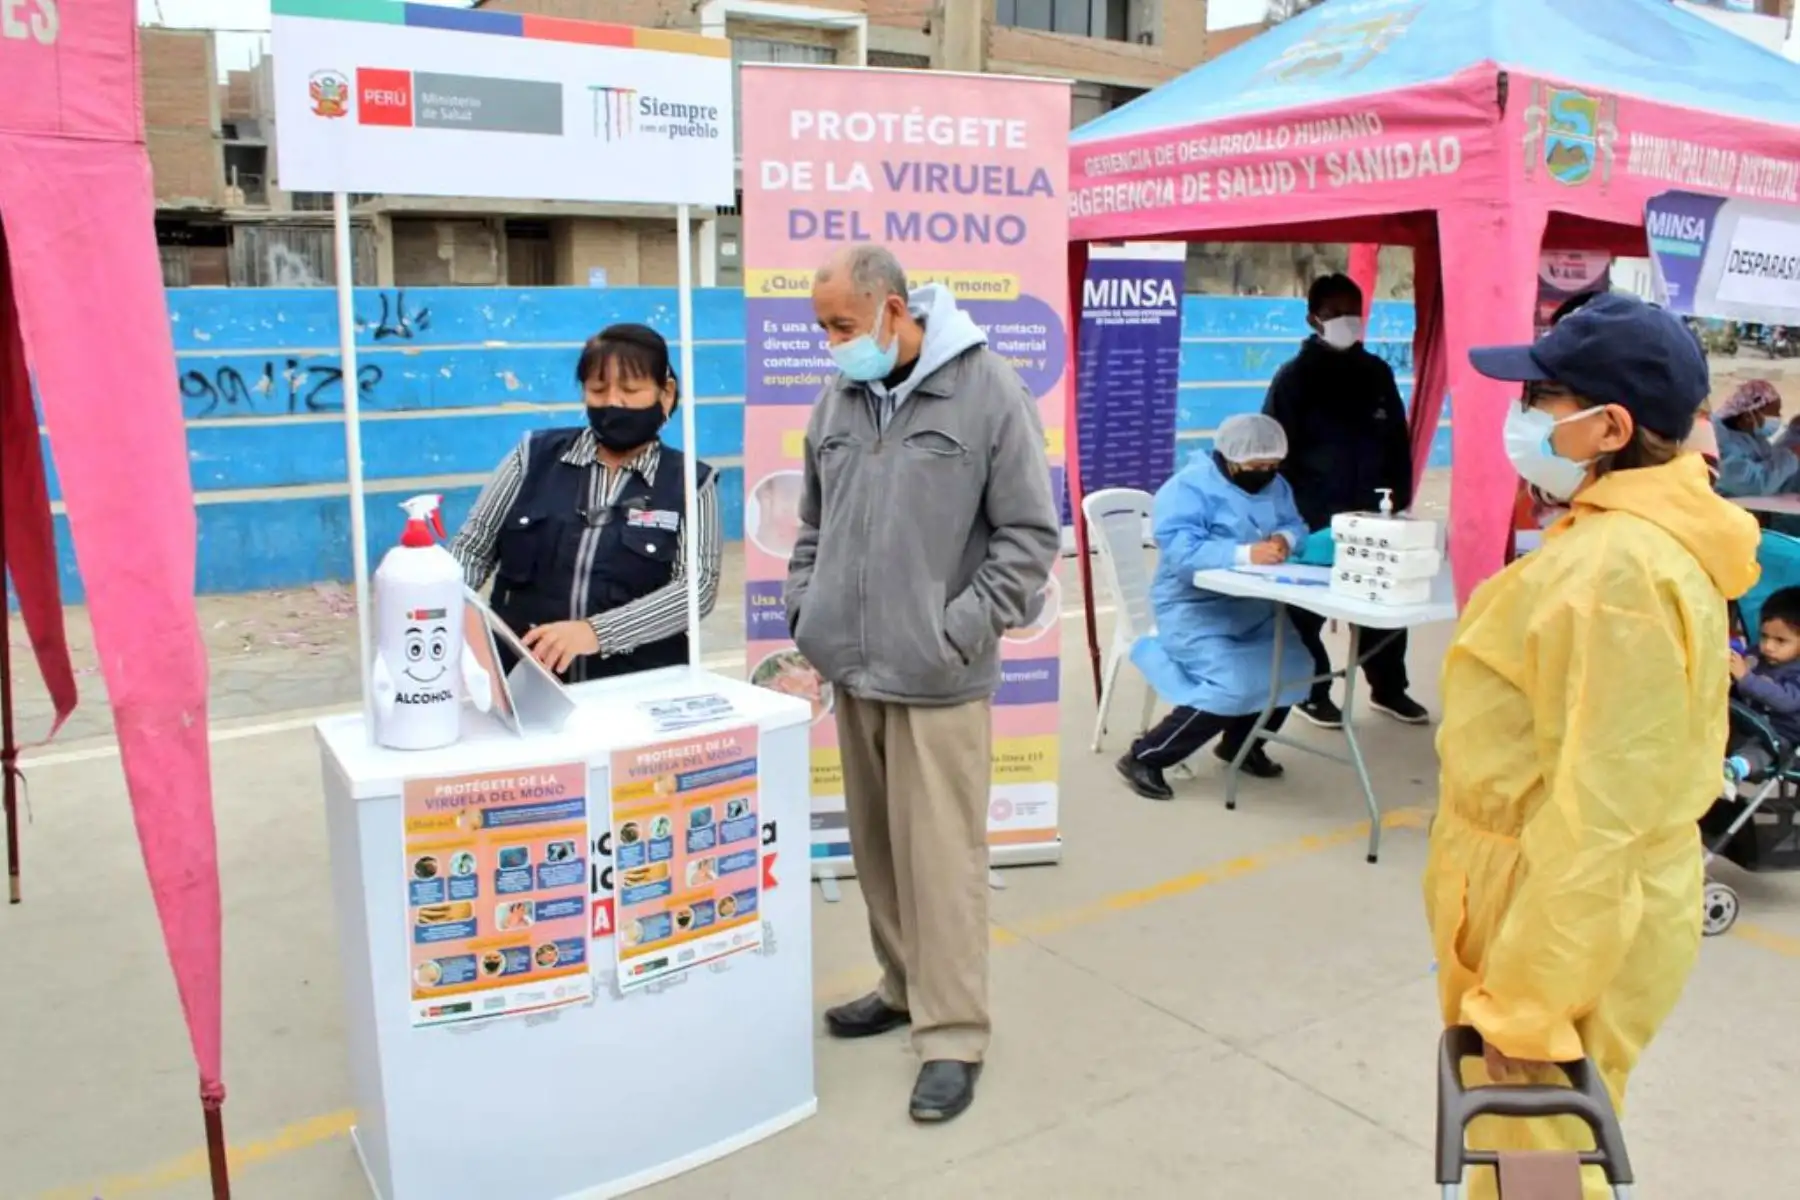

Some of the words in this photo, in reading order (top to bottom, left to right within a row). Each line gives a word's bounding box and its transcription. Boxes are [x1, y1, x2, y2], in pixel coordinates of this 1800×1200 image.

[364, 87, 407, 107] PERÚ
[639, 95, 718, 123] Siempre
[668, 122, 719, 140] pueblo
[790, 106, 1027, 149] PROTÉGETE
[1085, 148, 1151, 177] GERENCIA
[1155, 143, 1175, 166] DE
[1179, 129, 1290, 161] DESARROLLO
[1294, 112, 1383, 147] HUMANO
[760, 160, 813, 191] DE
[825, 160, 873, 192] LA
[882, 161, 1055, 198] VIRUELA
[1182, 171, 1212, 204] DE
[1217, 160, 1296, 200] SALUD
[1299, 155, 1317, 189] Y
[1325, 136, 1461, 187] SANIDAD
[1628, 131, 1736, 191] MUNICIPALIDAD
[1736, 155, 1798, 202] DISTRITAL
[788, 209, 870, 241] DEL
[885, 211, 1027, 246] MONO
[1649, 211, 1706, 241] MINSA
[760, 277, 809, 294] ¿Qué
[954, 279, 1011, 293] mono?
[1083, 279, 1177, 307] MINSA
[763, 320, 778, 333] Es
[782, 322, 807, 333] una
[995, 323, 1047, 334] contacto
[763, 337, 811, 350] directo
[997, 340, 1046, 352] material
[763, 373, 821, 388] erupción
[752, 594, 776, 606] Usa
[395, 692, 453, 704] ALCOHOL
[425, 794, 486, 812] VIRUELA
[490, 792, 516, 803] DEL
[520, 784, 565, 799] MONO
[435, 776, 516, 795] PROTÉGETE
[519, 774, 536, 786] DE
[540, 773, 557, 785] LA
